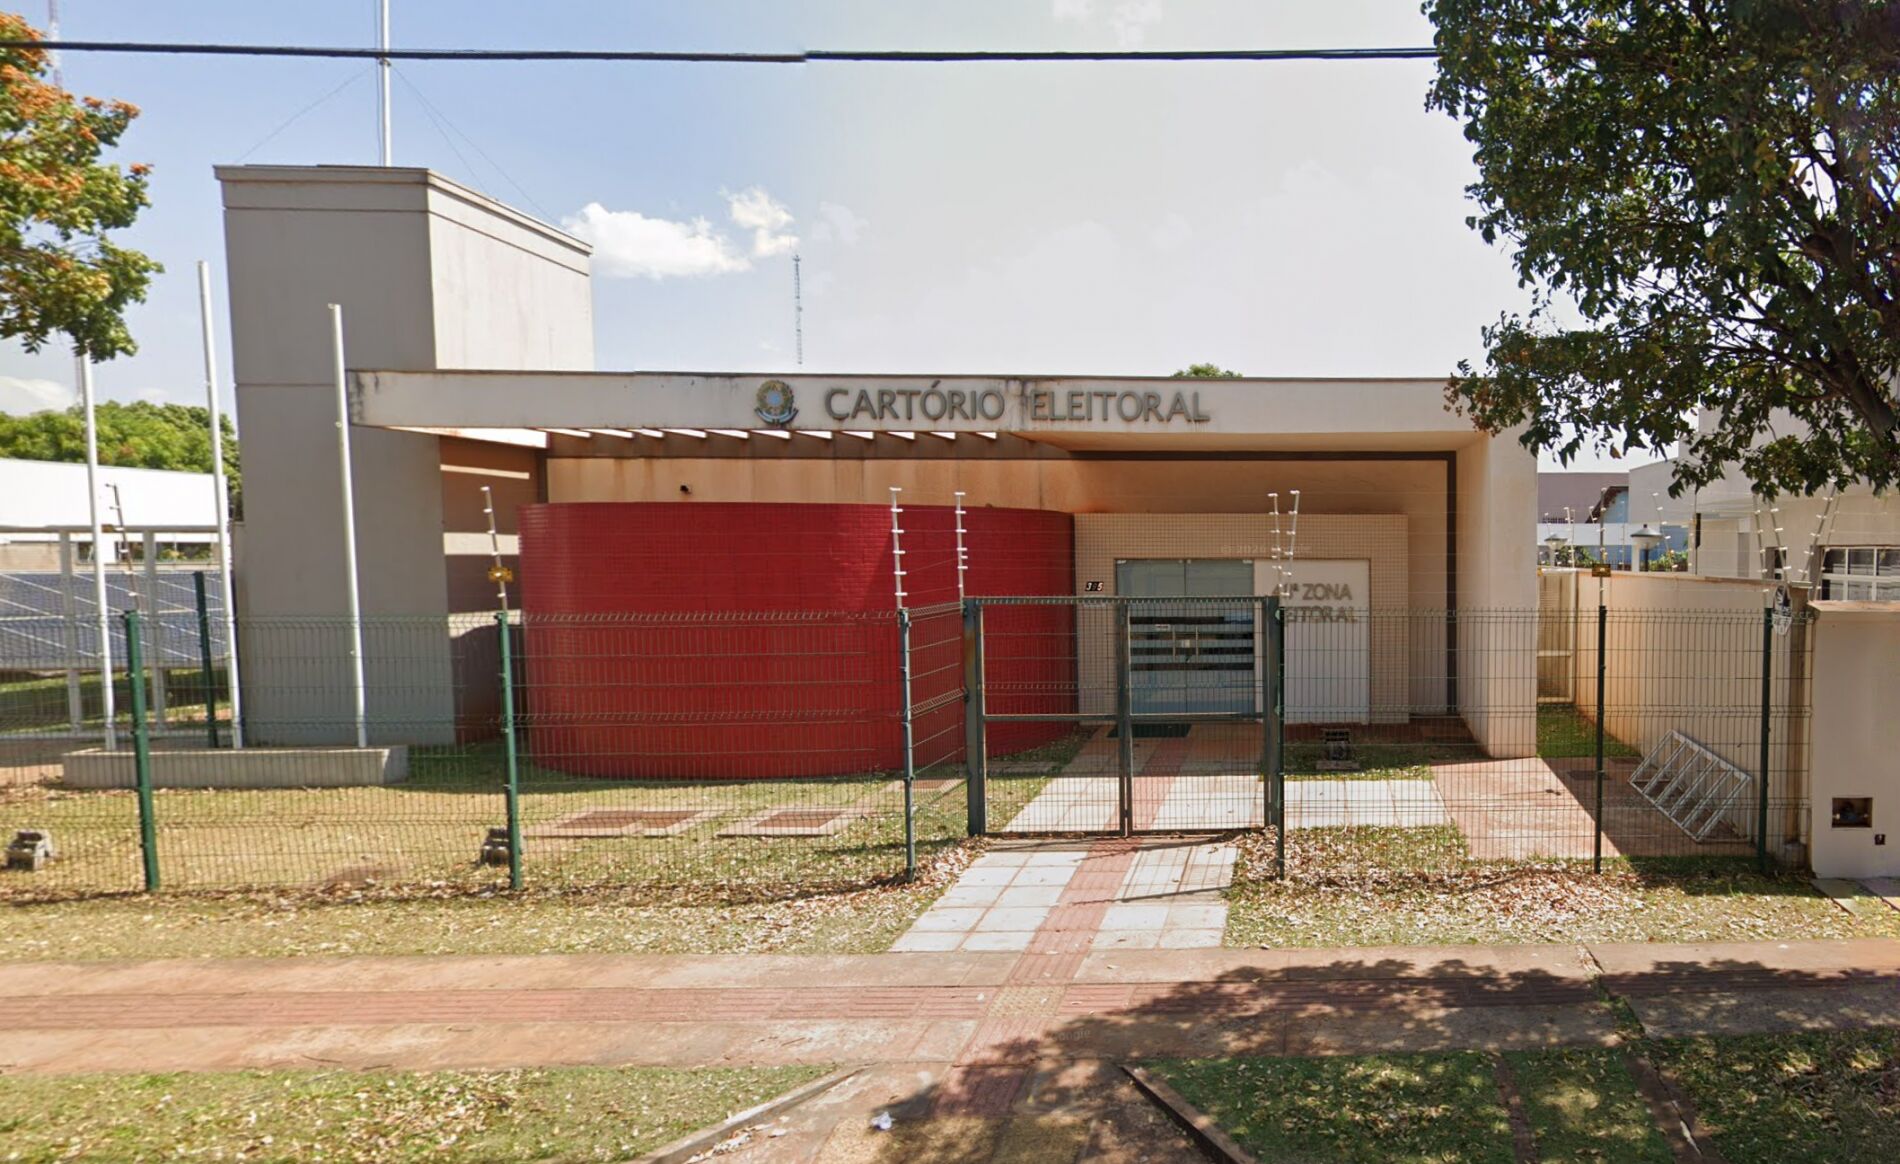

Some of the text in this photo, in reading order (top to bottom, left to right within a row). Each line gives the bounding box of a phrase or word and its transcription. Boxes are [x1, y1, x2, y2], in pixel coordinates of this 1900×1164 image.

[825, 381, 1210, 423] CARTÓRIO ELEITORAL
[1302, 583, 1352, 601] ZONA
